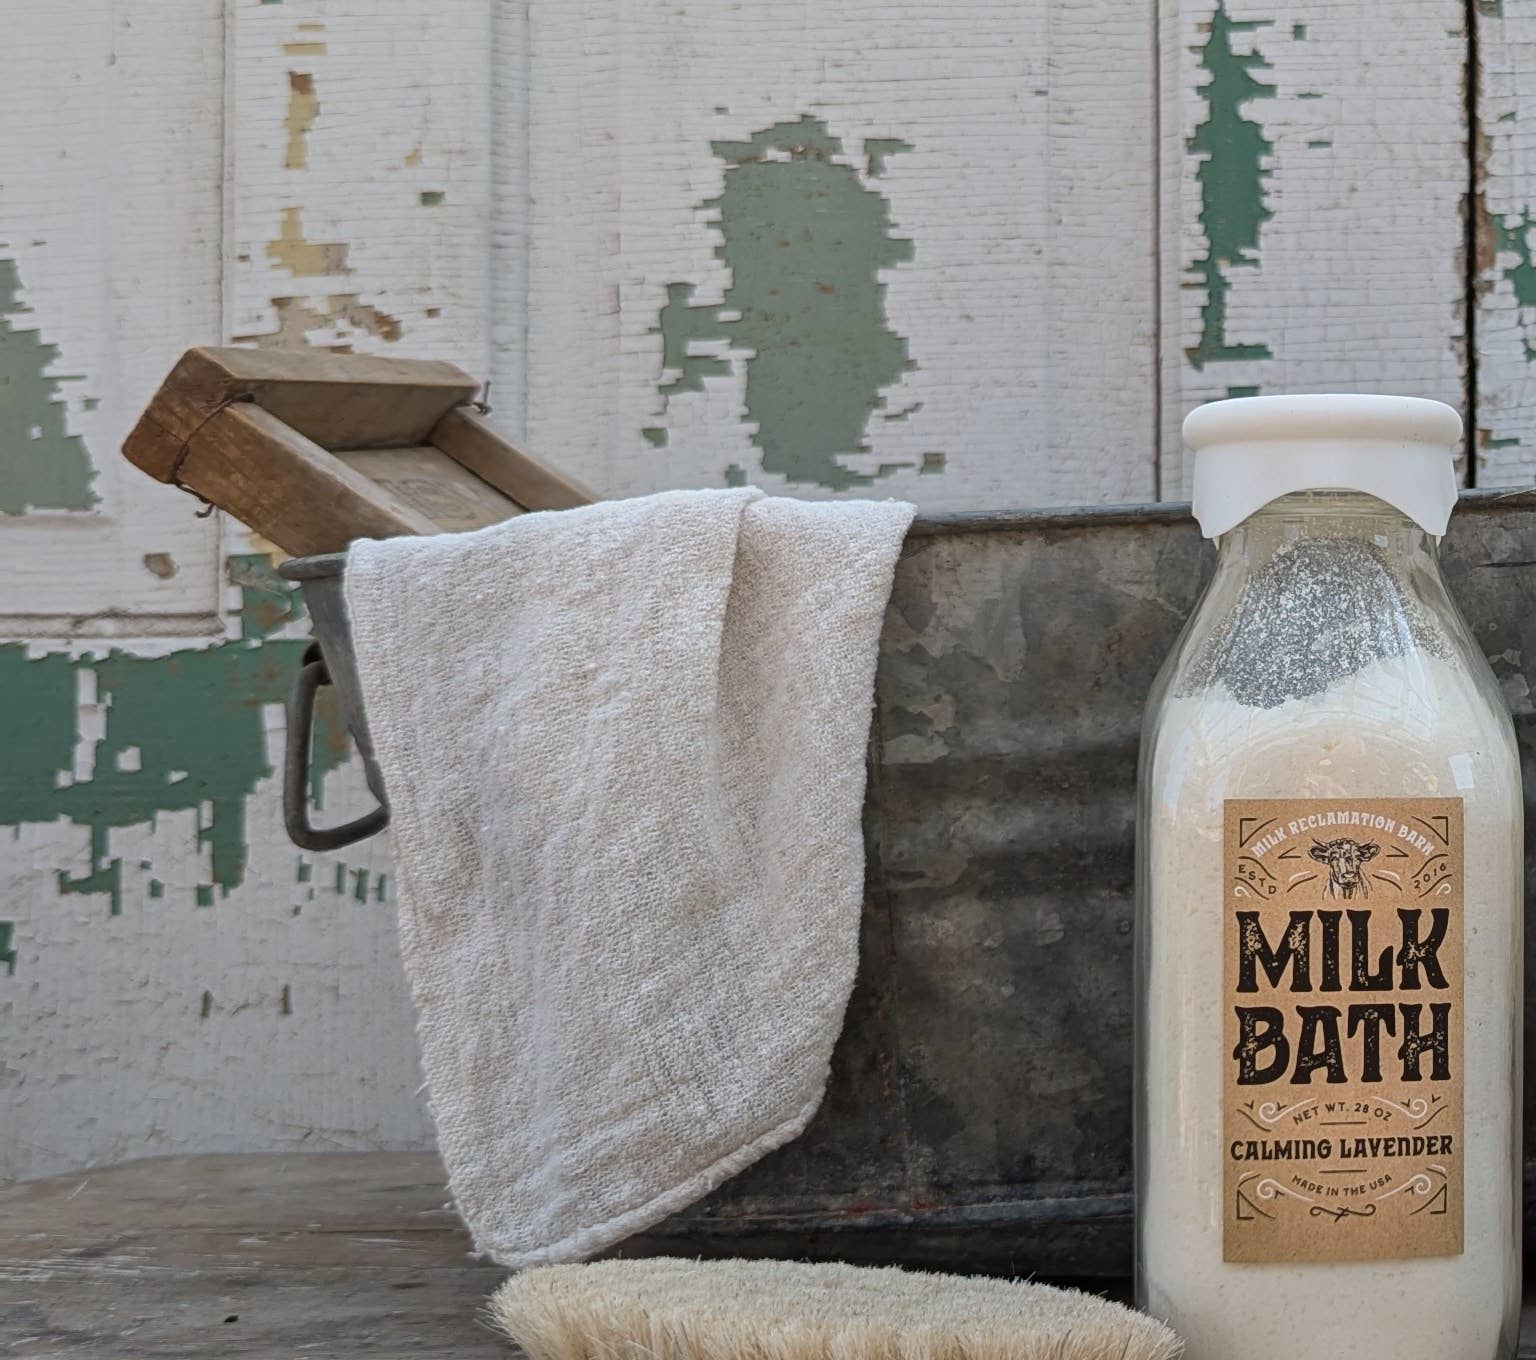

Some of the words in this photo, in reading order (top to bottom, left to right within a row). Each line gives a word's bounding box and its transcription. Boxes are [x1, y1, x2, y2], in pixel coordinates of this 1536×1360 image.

[1251, 828, 1287, 858] MILK
[1289, 811, 1394, 836] RECLAMATION
[1397, 821, 1435, 856] BARN
[1238, 864, 1277, 895] ESTD
[1414, 862, 1447, 889] 2016
[1235, 908, 1449, 992] MILK
[1233, 1003, 1451, 1085] BATH
[1293, 1106, 1319, 1125] NET
[1325, 1102, 1349, 1112] WT.
[1354, 1103, 1370, 1113] 28
[1375, 1107, 1393, 1122] OZ
[1231, 1140, 1332, 1160] CALMING
[1340, 1135, 1453, 1158] LAVENDER
[1292, 1175, 1323, 1195] MADE
[1327, 1187, 1339, 1196] IN
[1343, 1186, 1366, 1196] THE
[1370, 1174, 1393, 1191] USA
